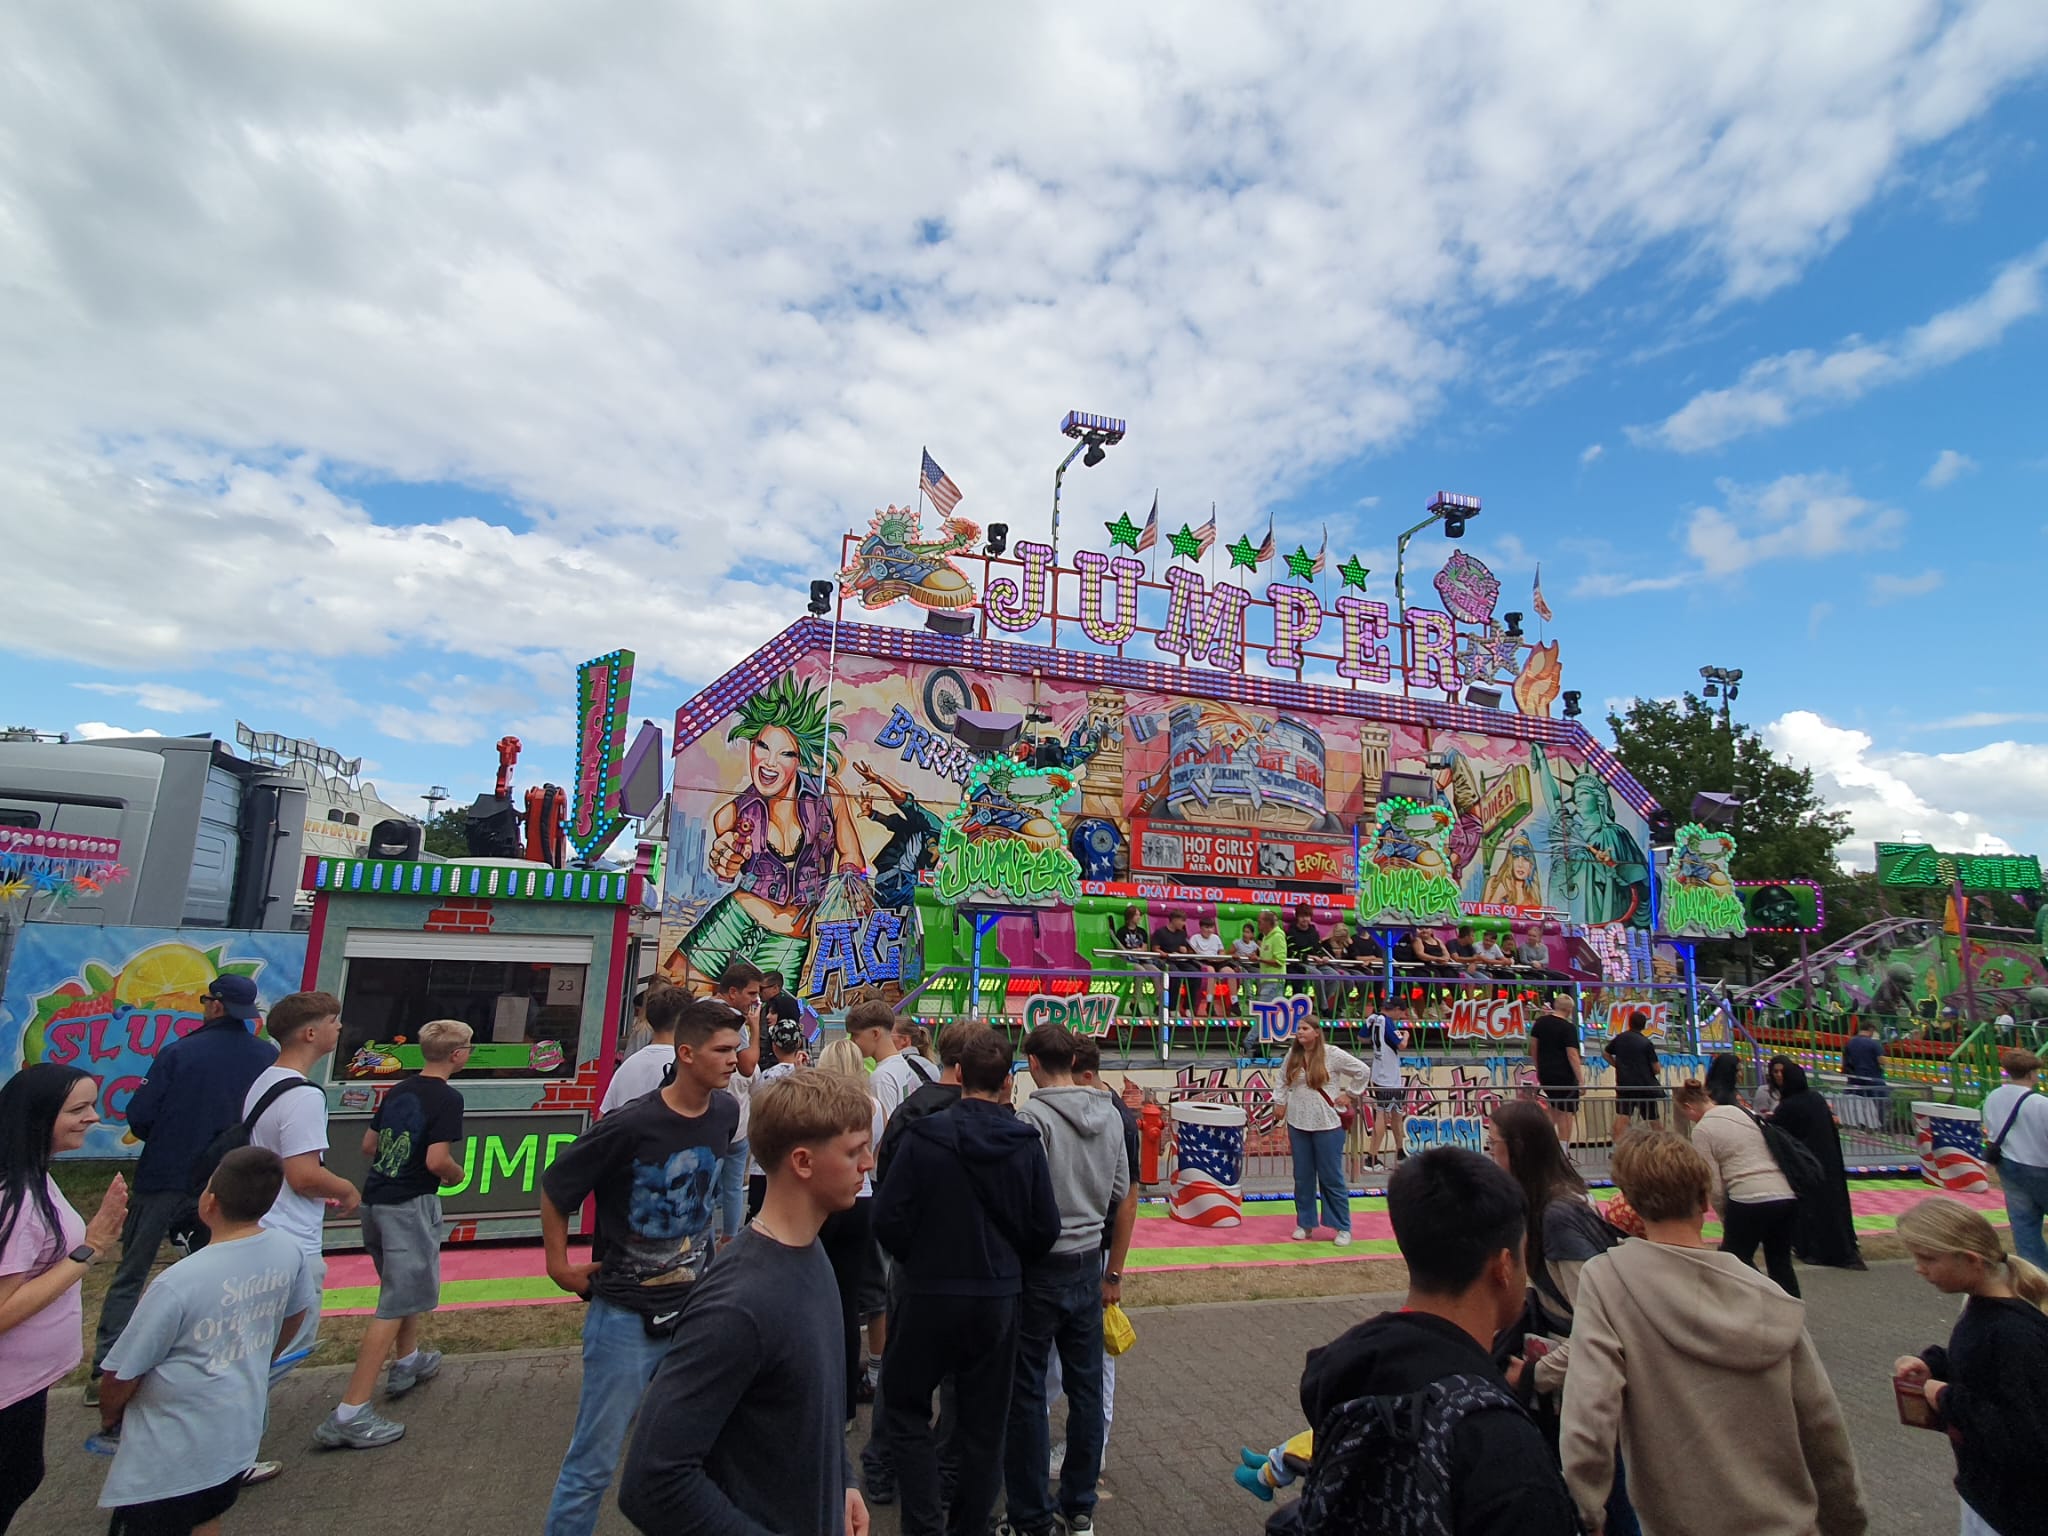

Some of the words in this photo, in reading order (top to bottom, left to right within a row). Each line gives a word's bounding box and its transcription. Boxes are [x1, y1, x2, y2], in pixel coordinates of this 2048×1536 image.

[984, 540, 1462, 692] JUMPER
[577, 665, 609, 836] TICKETS
[1482, 784, 1513, 823] DINER
[1185, 836, 1213, 854] HOT
[1215, 838, 1254, 857] GIRLS
[1264, 832, 1283, 840] ALL
[1287, 834, 1318, 842] COLOR
[1186, 854, 1206, 863] FOR
[1190, 863, 1212, 872] MEN
[1214, 857, 1252, 875] ONLY
[1296, 851, 1338, 875] EROTICA
[1085, 881, 1106, 895] GO
[1137, 884, 1170, 897] OKAY
[1173, 886, 1202, 899] LETS
[1205, 887, 1223, 900] GO
[1252, 890, 1282, 904] OKAY
[1285, 892, 1311, 906] LETS
[1313, 894, 1330, 907] GO
[1479, 904, 1501, 916] LETS
[1503, 905, 1517, 916] GO
[557, 980, 574, 992] 23
[1026, 996, 1116, 1037] CRAZY
[1252, 998, 1311, 1041] TOP
[1450, 1000, 1526, 1038] MEGA
[49, 1014, 204, 1065] SLU
[1405, 1117, 1482, 1155] SPLASH
